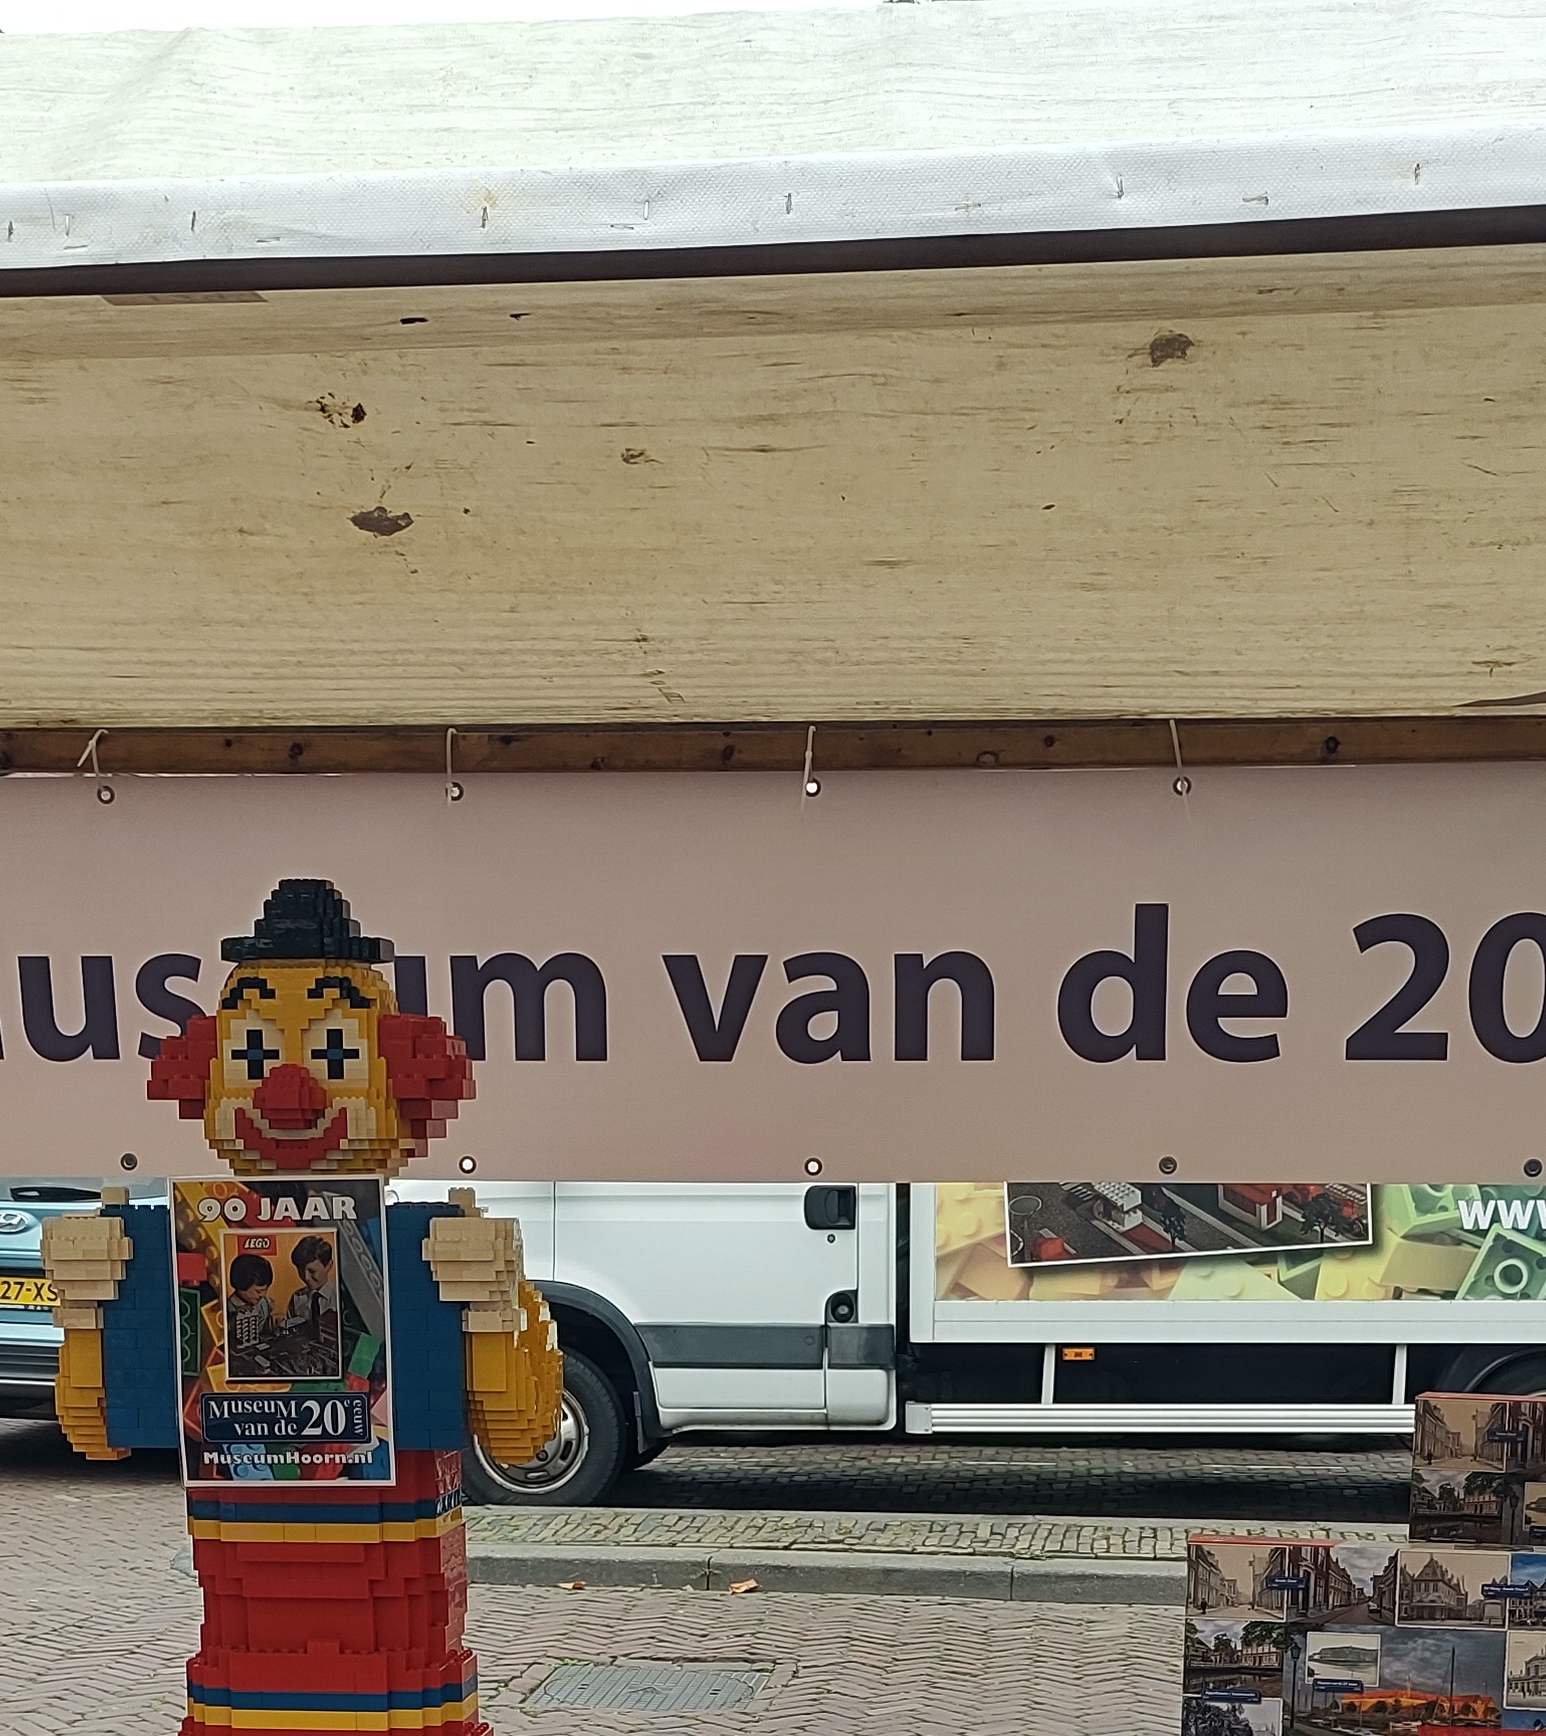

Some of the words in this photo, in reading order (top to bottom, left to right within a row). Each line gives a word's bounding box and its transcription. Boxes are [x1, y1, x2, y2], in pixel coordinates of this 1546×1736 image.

[661, 952, 995, 1064] van
[1056, 901, 1289, 1063] de
[198, 1198, 247, 1222] 90
[257, 1196, 357, 1221] JAAR
[244, 1237, 270, 1249] LEGO
[233, 1420, 269, 1436] van
[275, 1419, 298, 1435] de
[300, 1399, 346, 1436] 20
[203, 1450, 373, 1466] MuseumHoorn.nl
